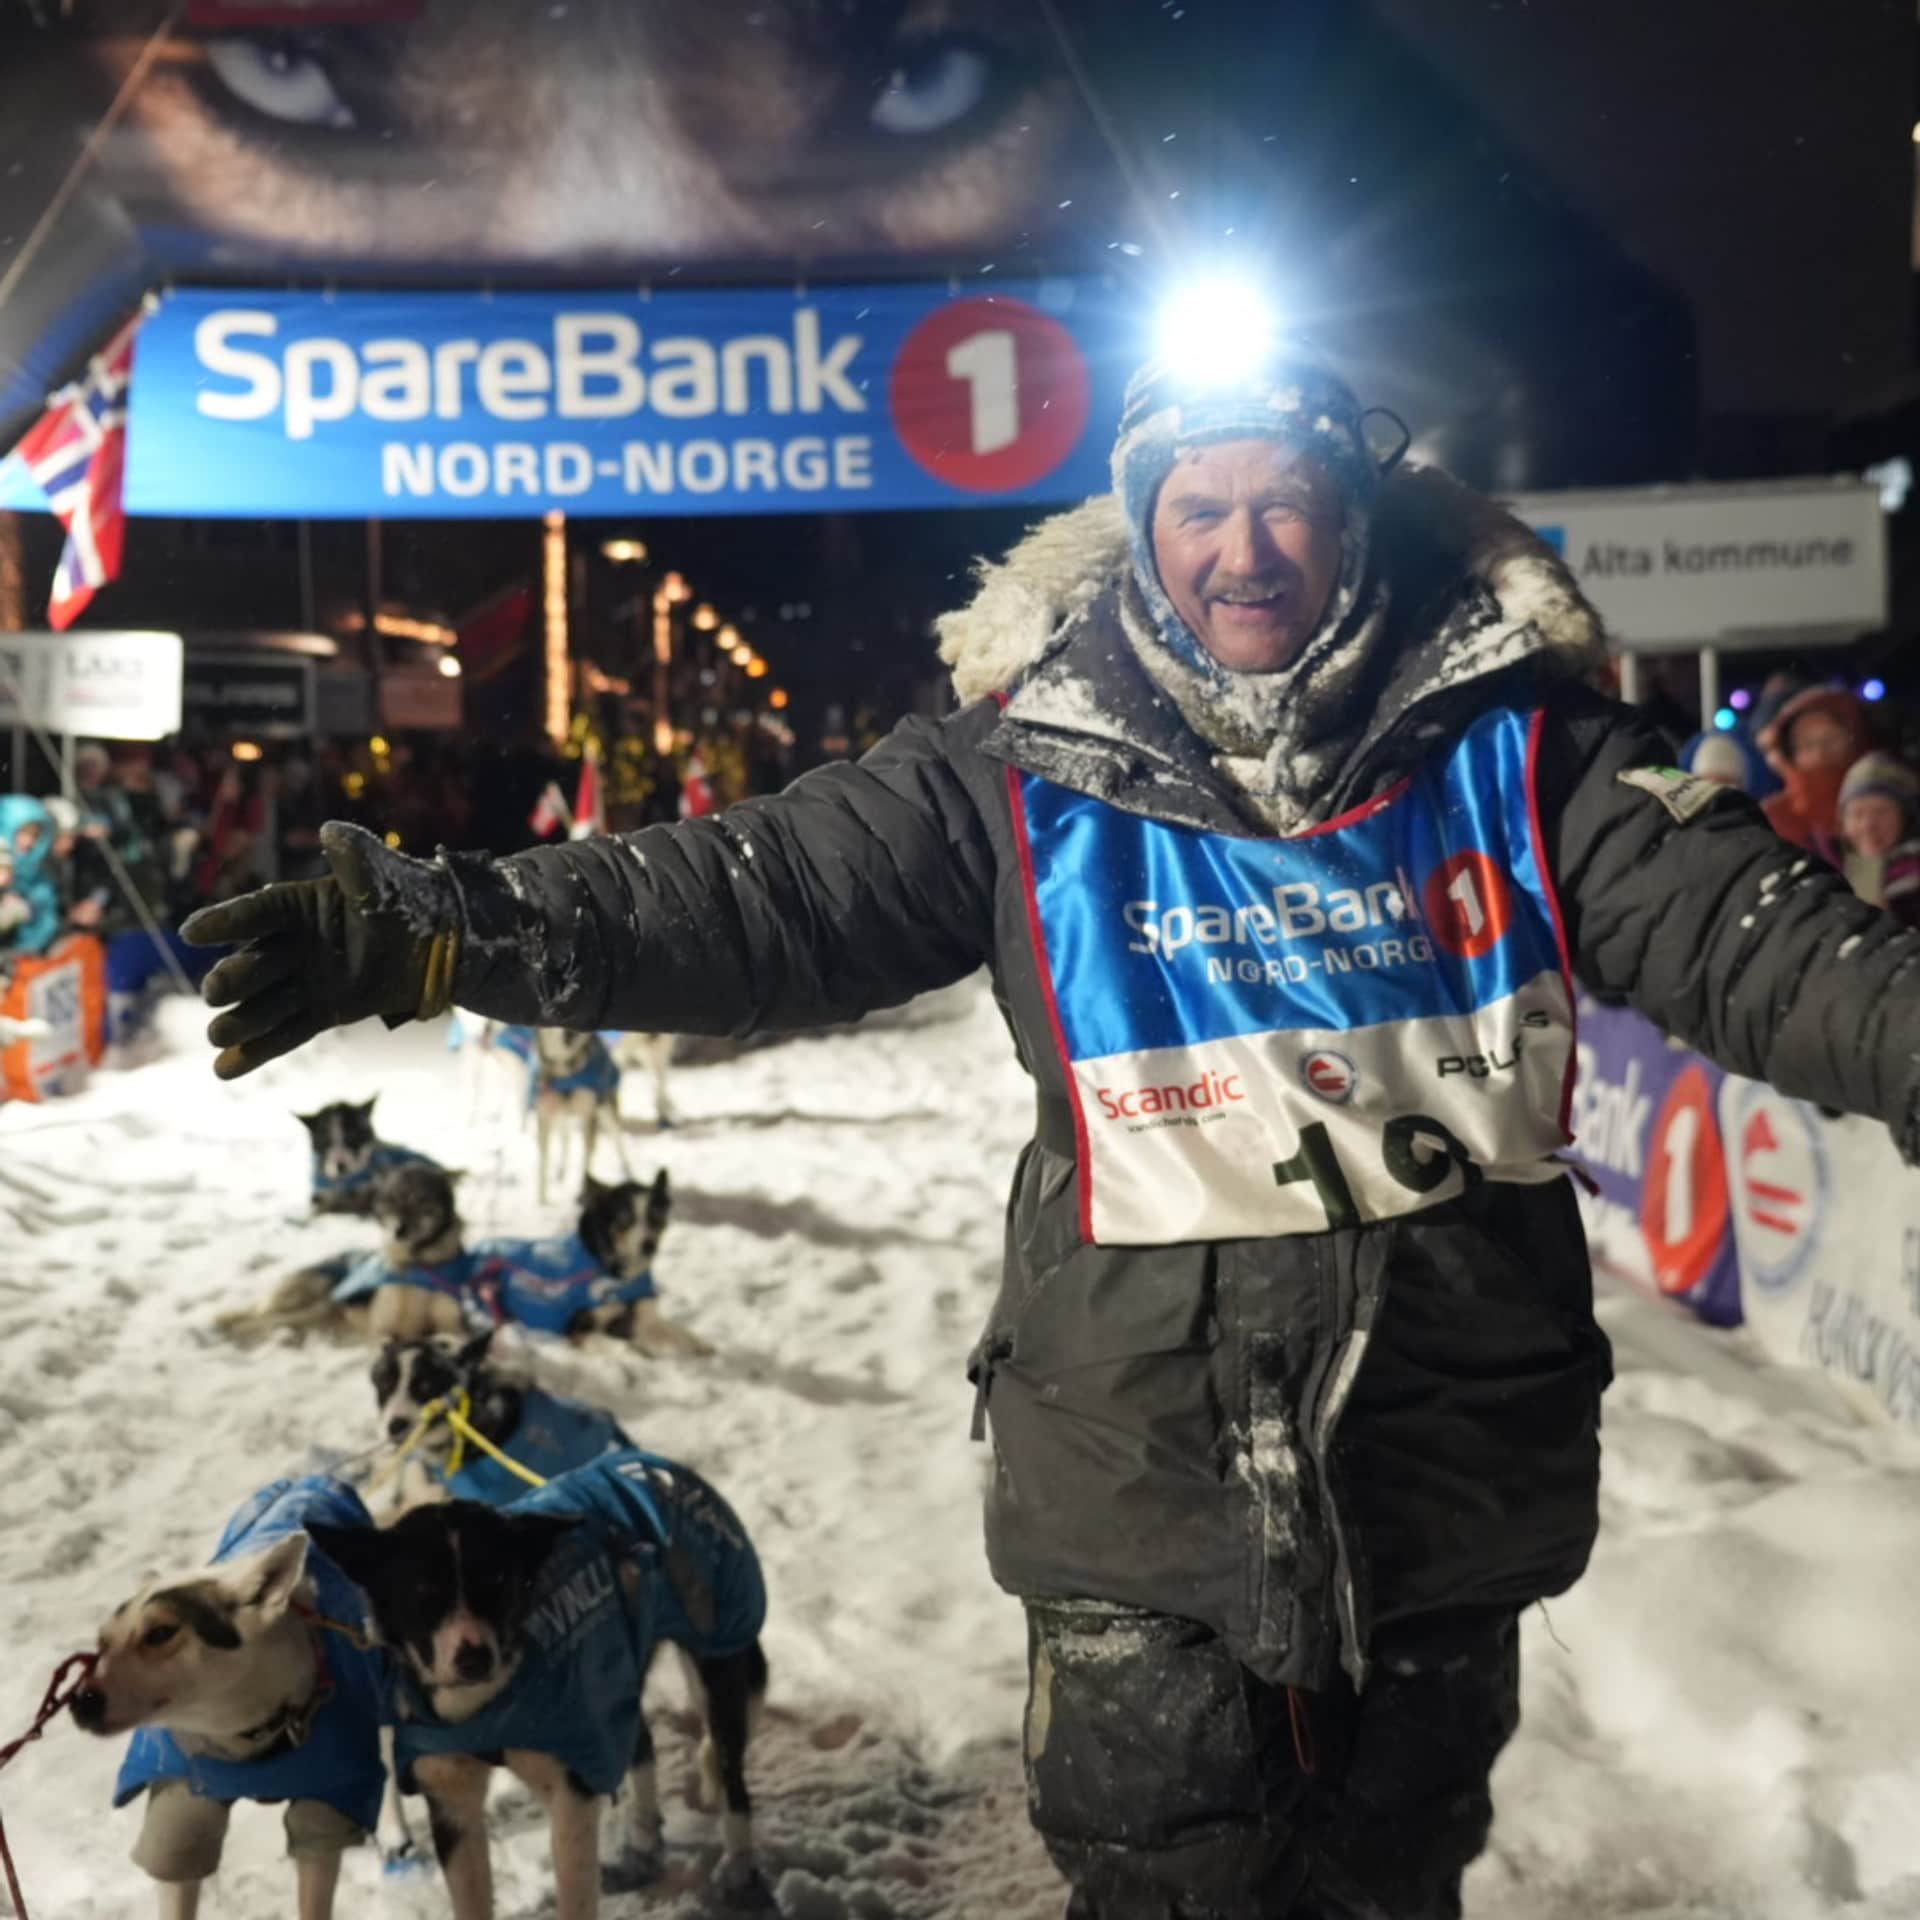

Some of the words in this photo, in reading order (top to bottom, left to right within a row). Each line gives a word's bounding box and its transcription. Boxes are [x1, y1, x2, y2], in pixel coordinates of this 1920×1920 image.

[194, 308, 867, 440] SpareBank
[946, 329, 1019, 456] 1
[382, 437, 873, 496] NORD-NORGE
[1582, 543, 1652, 577] Alta
[1661, 536, 1855, 575] kommune
[1444, 868, 1486, 937] 1
[1206, 935, 1437, 985] NORD-NORG
[1096, 1069, 1245, 1120] Scandic
[1663, 1104, 1697, 1247] 1
